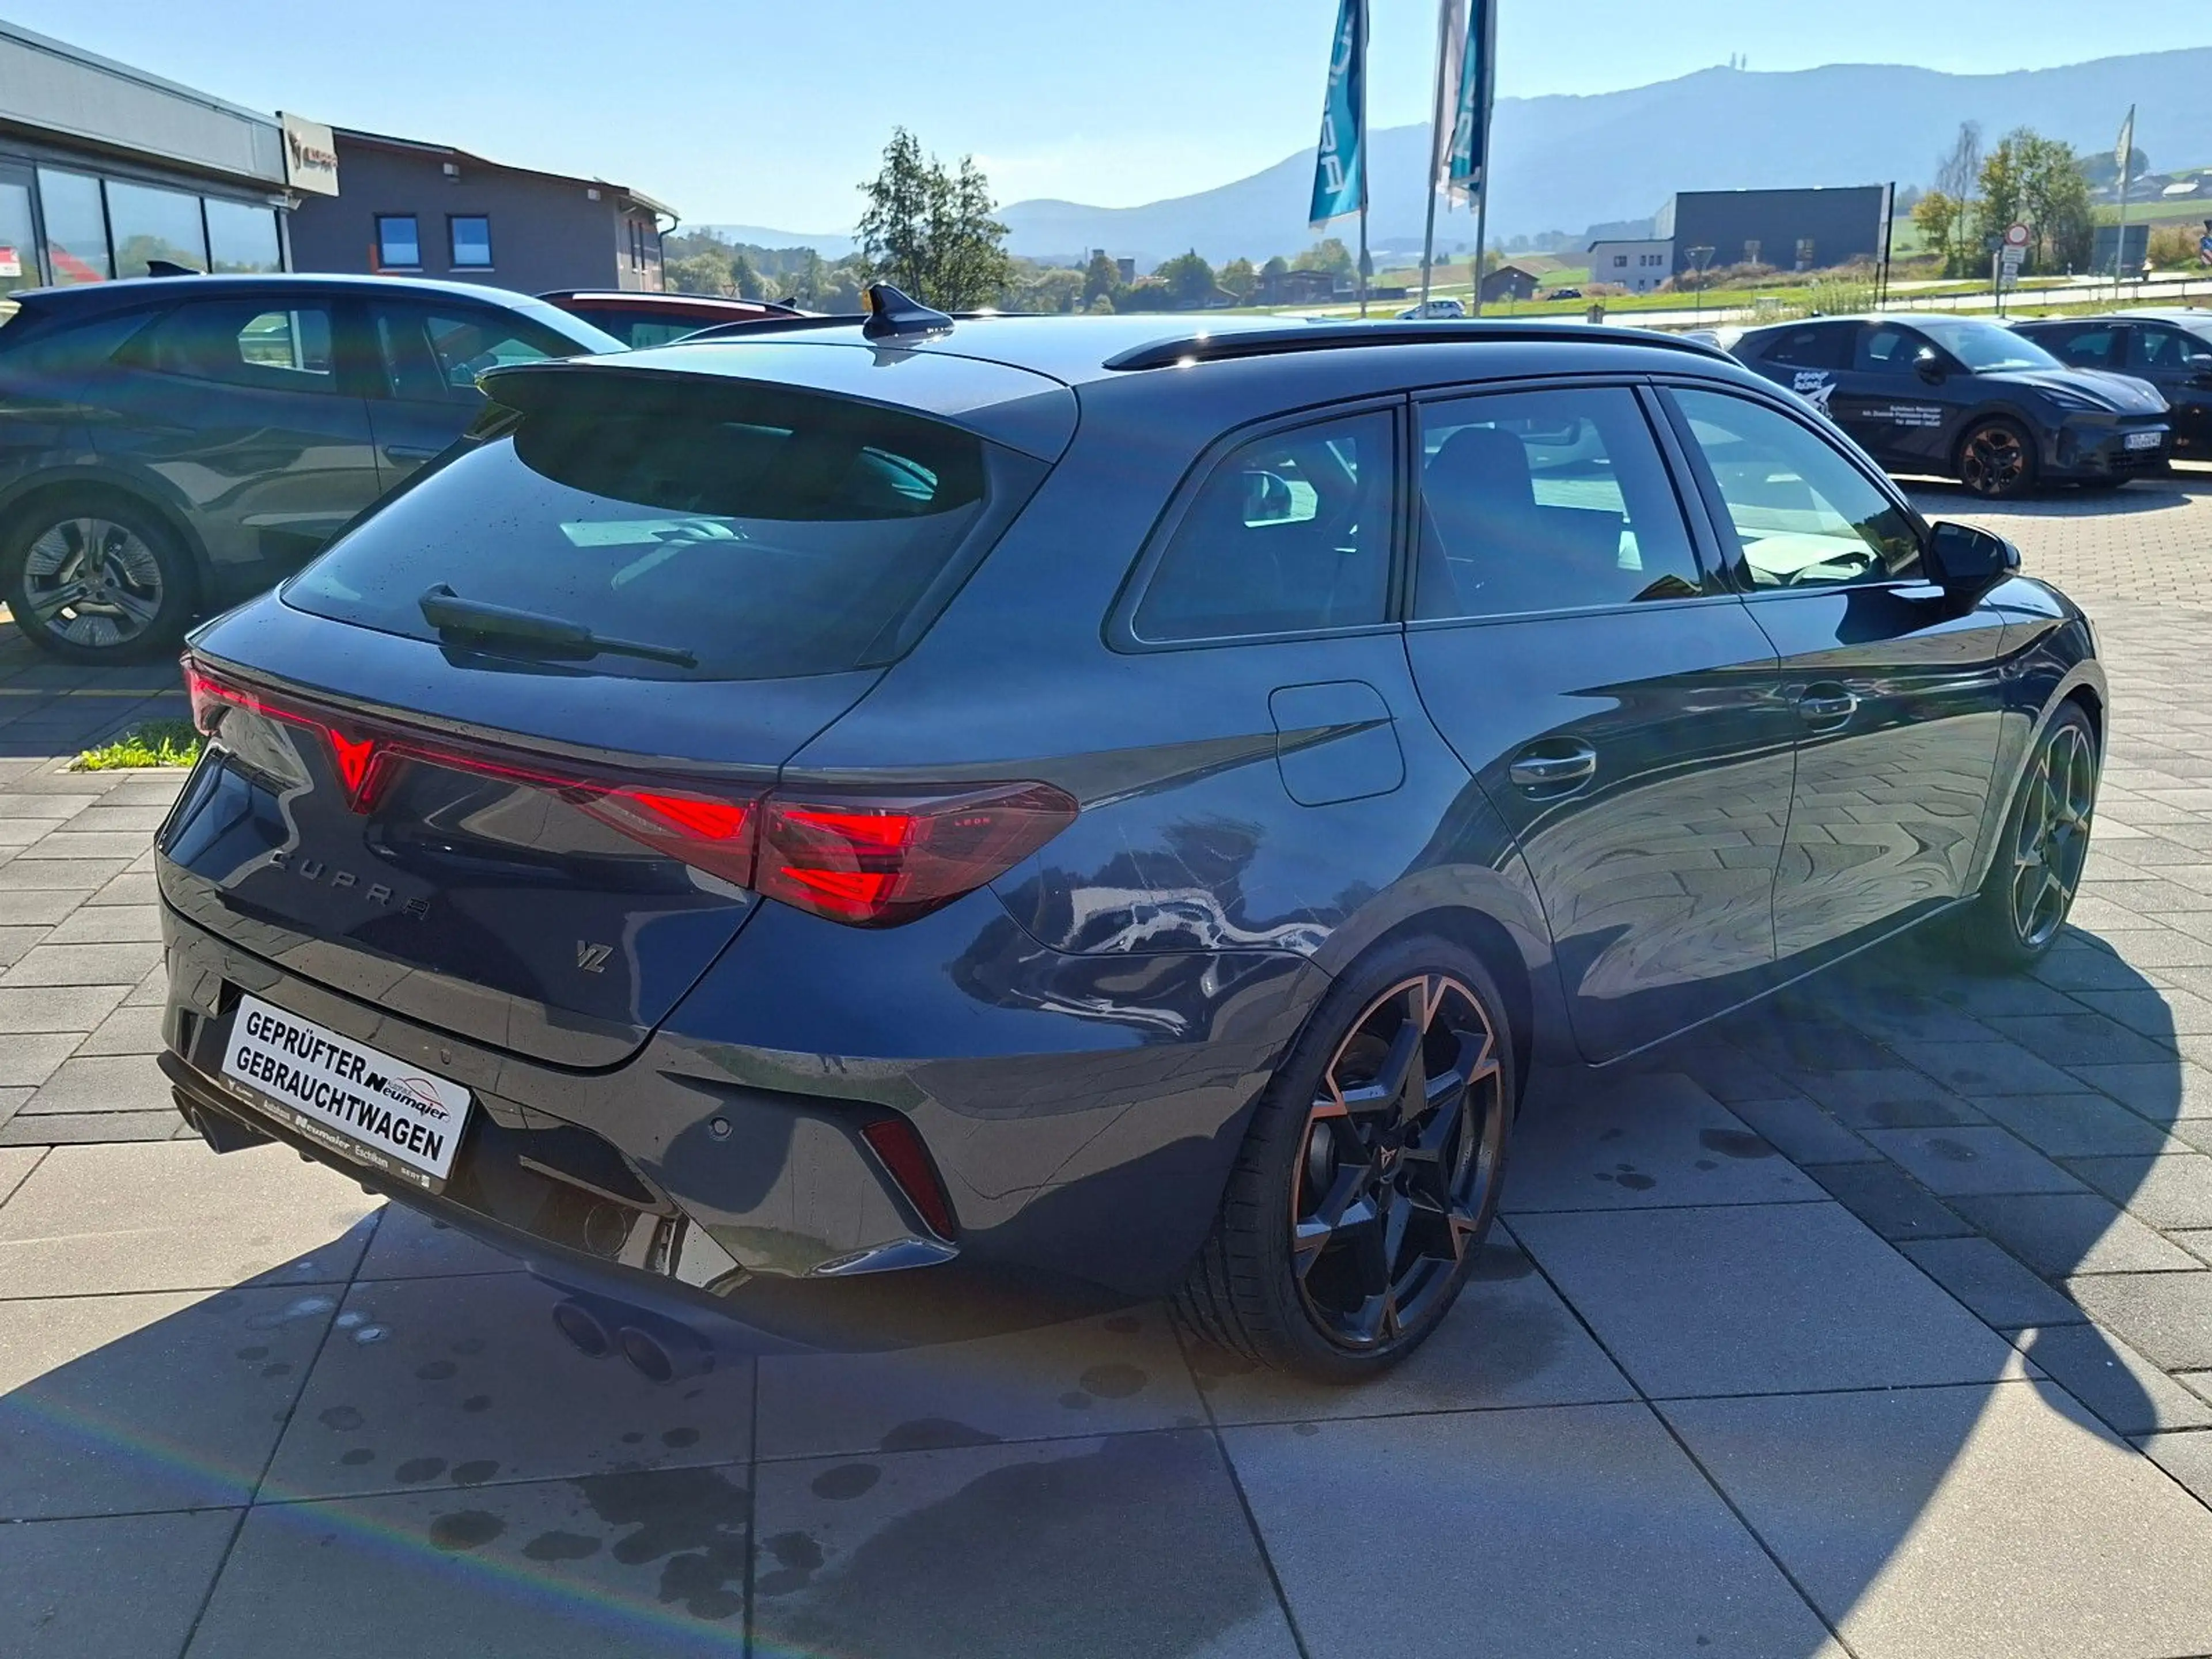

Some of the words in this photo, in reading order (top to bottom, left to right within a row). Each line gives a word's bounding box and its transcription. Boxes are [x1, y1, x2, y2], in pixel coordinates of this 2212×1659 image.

[270, 850, 430, 921] CUPRA
[247, 1011, 366, 1084] GEPRÜFTER
[237, 1046, 444, 1161] GEBRAUCHTWAGEN
[363, 1071, 449, 1120] Neumaier
[296, 1115, 350, 1150] Neumaier
